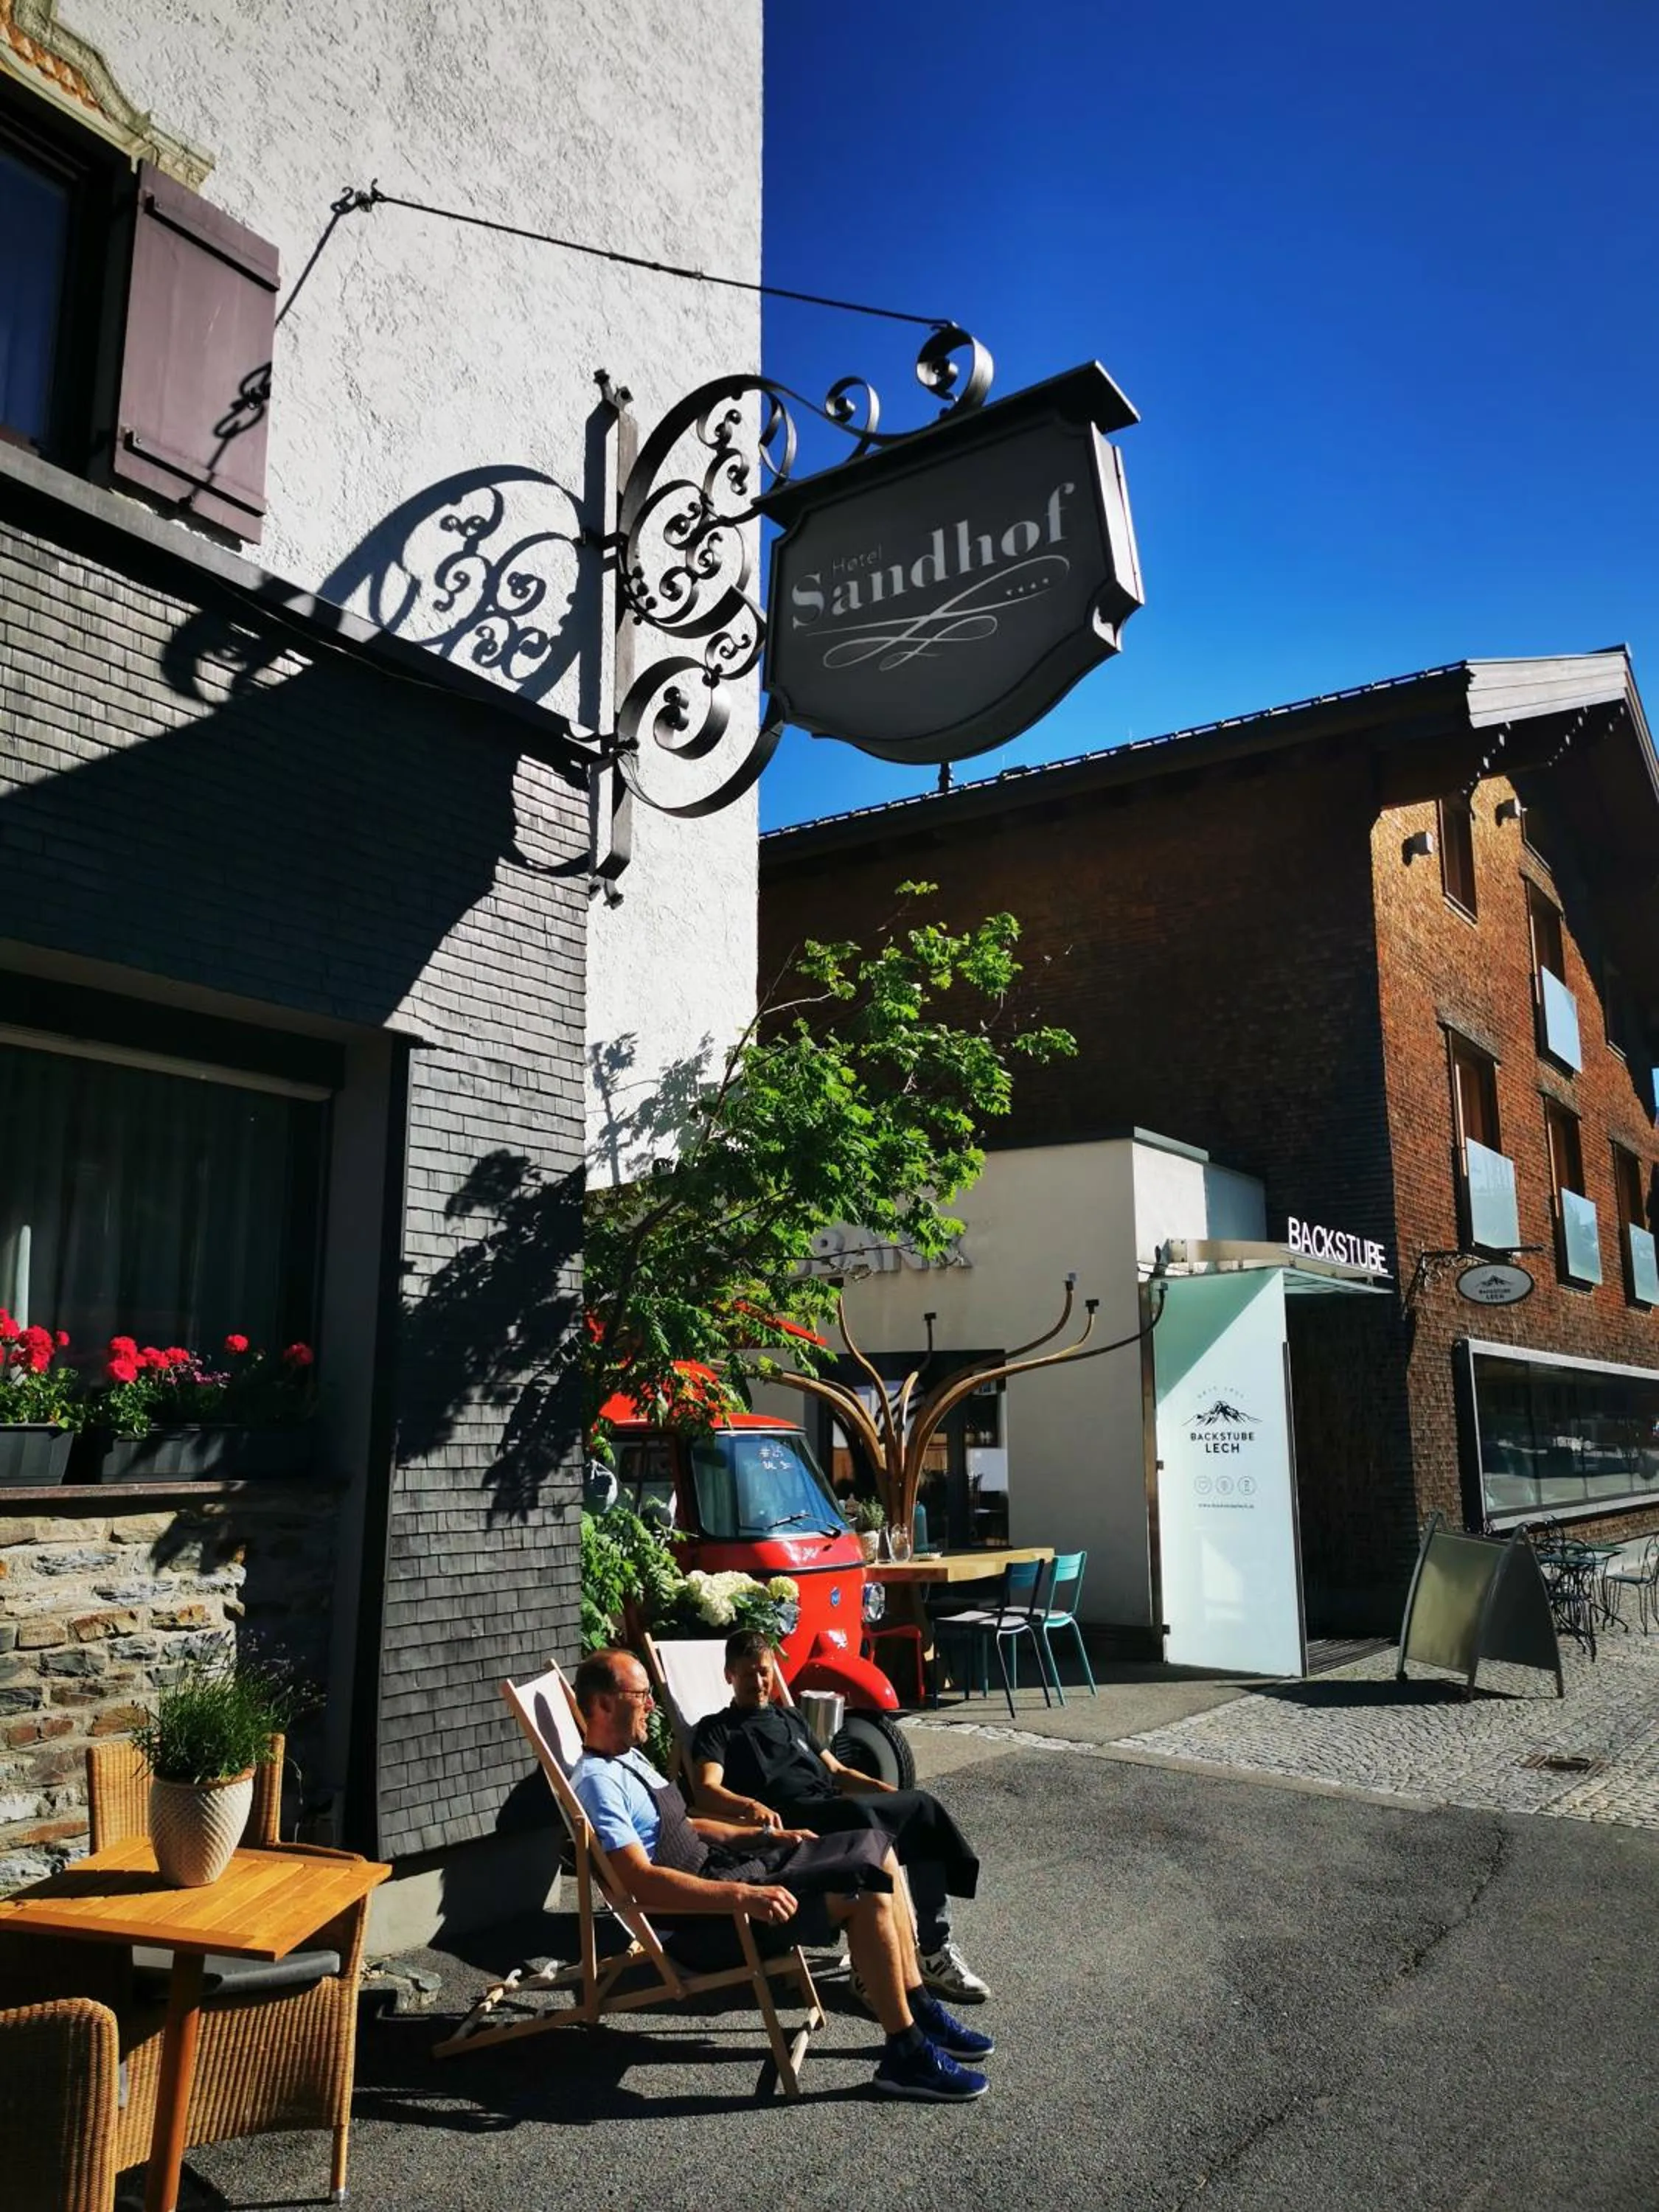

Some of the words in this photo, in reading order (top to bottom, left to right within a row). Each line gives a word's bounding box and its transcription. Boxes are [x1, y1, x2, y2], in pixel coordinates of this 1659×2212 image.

[792, 482, 1075, 630] Sandhof
[832, 543, 882, 577] Hotel
[1288, 1216, 1388, 1273] BACKSTUBE
[1190, 1432, 1255, 1441] BACKSTUBE
[1206, 1443, 1240, 1453] LECH
